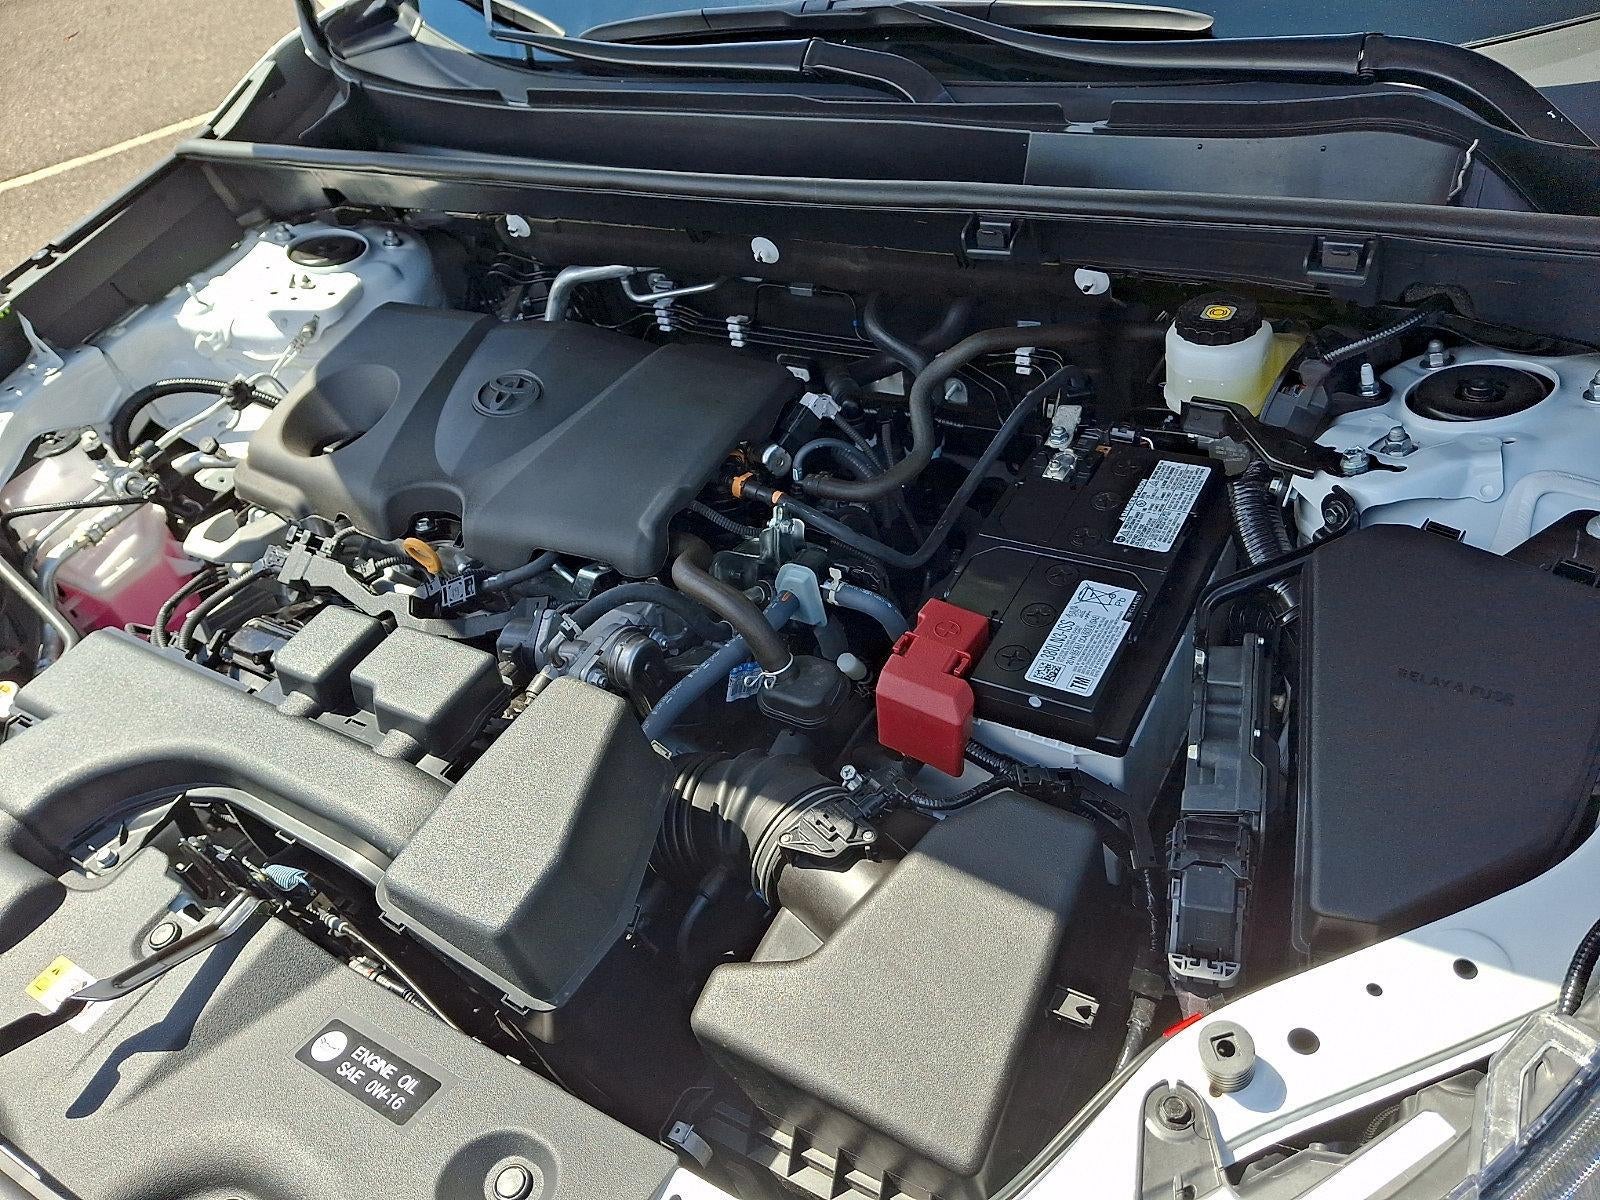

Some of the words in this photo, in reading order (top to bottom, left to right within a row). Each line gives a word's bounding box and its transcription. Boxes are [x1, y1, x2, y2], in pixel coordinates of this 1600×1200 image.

[1069, 676, 1091, 690] TM
[336, 1061, 366, 1085] SAE
[364, 1081, 406, 1111] 0W-16
[351, 1045, 398, 1080] ENGINE
[397, 1074, 421, 1096] OIL
